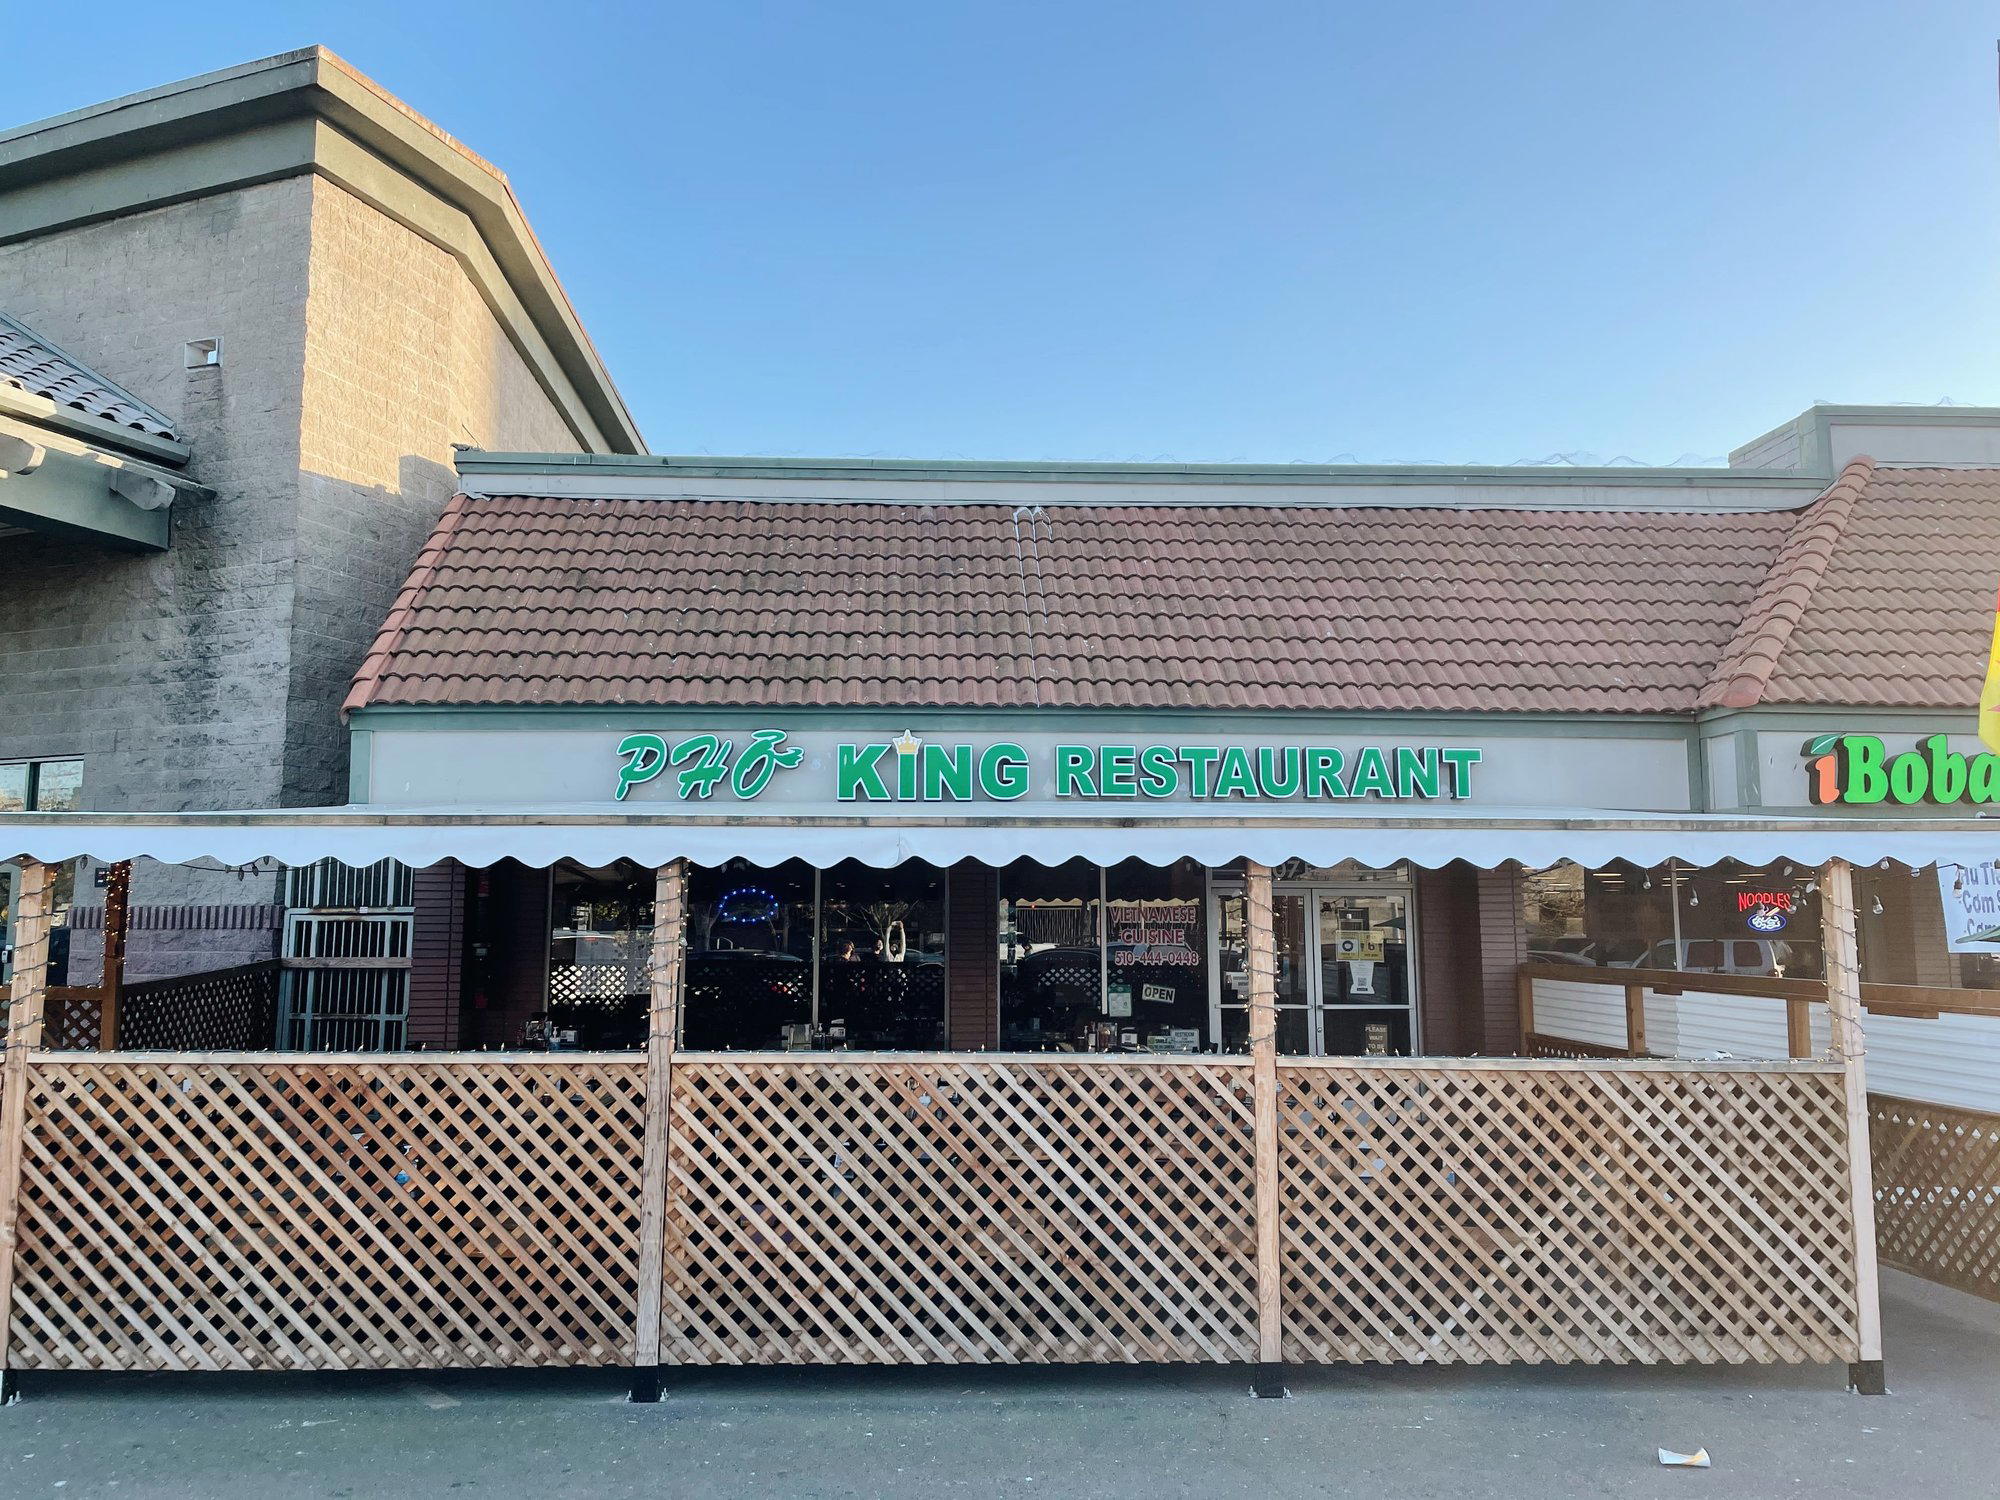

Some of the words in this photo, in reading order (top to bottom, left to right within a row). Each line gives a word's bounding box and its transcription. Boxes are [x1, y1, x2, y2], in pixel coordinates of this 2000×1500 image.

[837, 738, 1030, 800] KING
[1055, 745, 1483, 799] RESTAURANT
[1808, 733, 2000, 804] iBoba
[1738, 892, 1793, 912] NOODLES
[1109, 906, 1196, 923] VIETNAMESE
[1120, 928, 1185, 945] CUISINE
[1114, 950, 1199, 965] 510-444-0448
[1144, 986, 1174, 1001] OPEN
